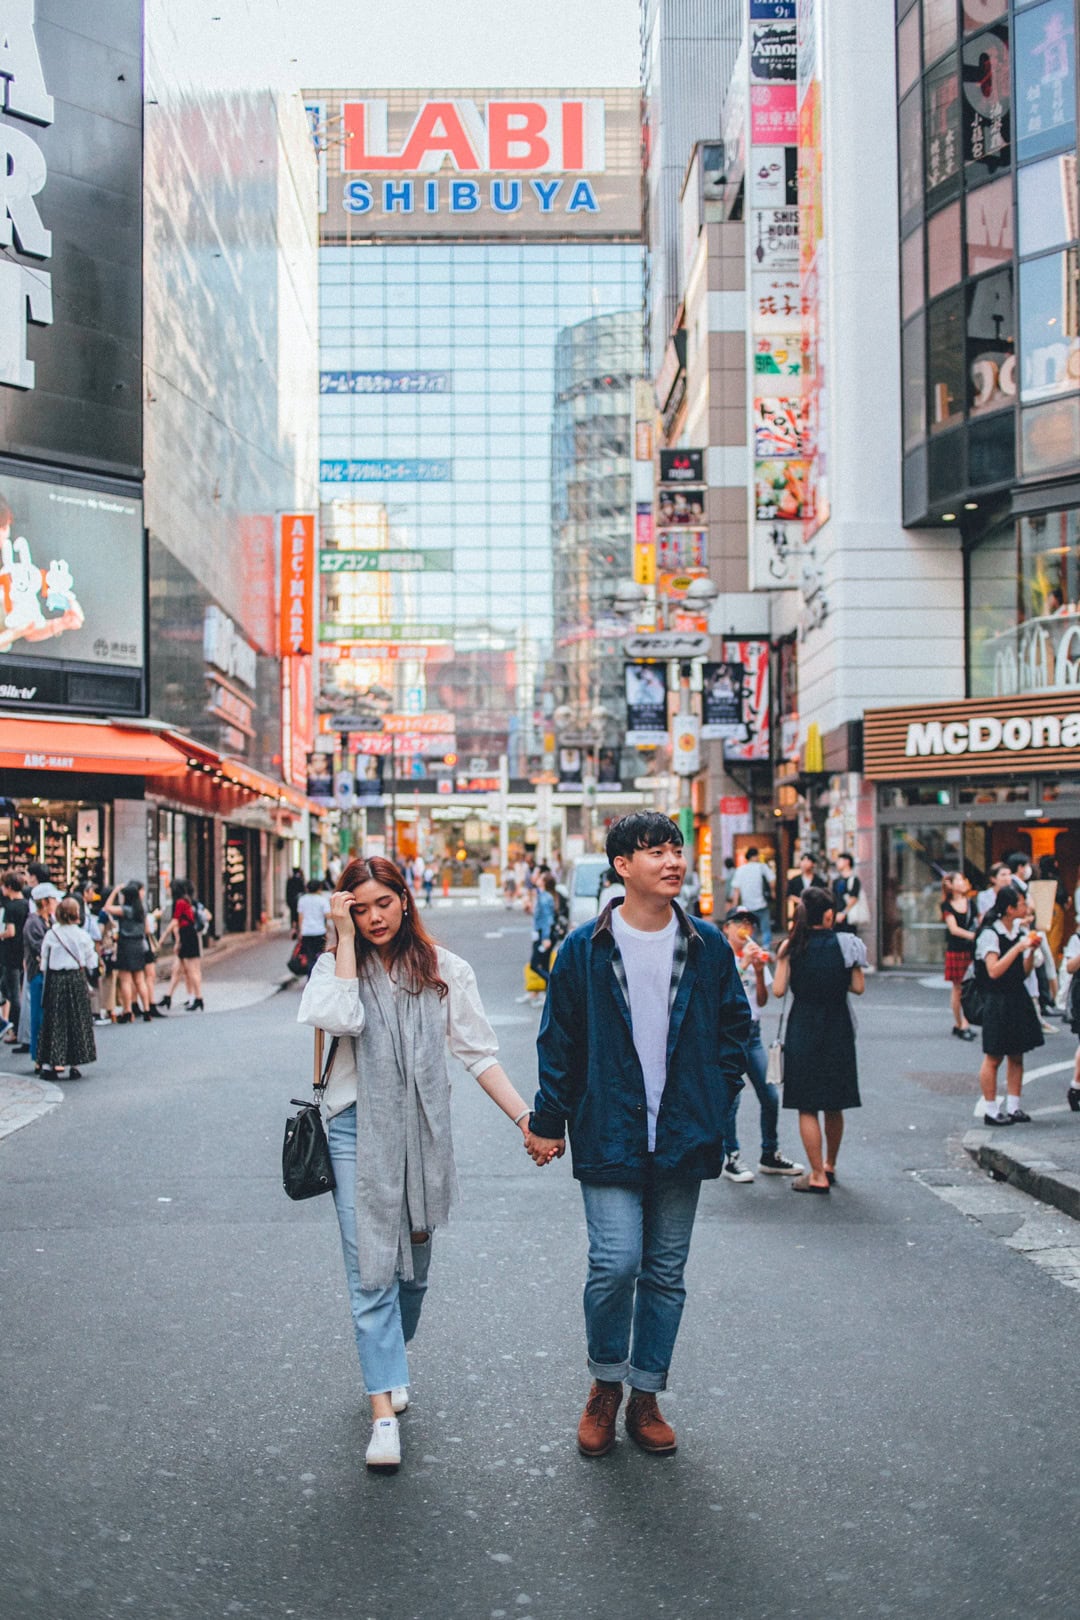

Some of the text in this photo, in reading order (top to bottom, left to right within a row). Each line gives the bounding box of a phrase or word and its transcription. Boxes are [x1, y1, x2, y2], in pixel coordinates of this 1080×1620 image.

[342, 101, 588, 171] LABI
[343, 179, 601, 214] SHIBUYA
[905, 715, 1080, 757] McDona
